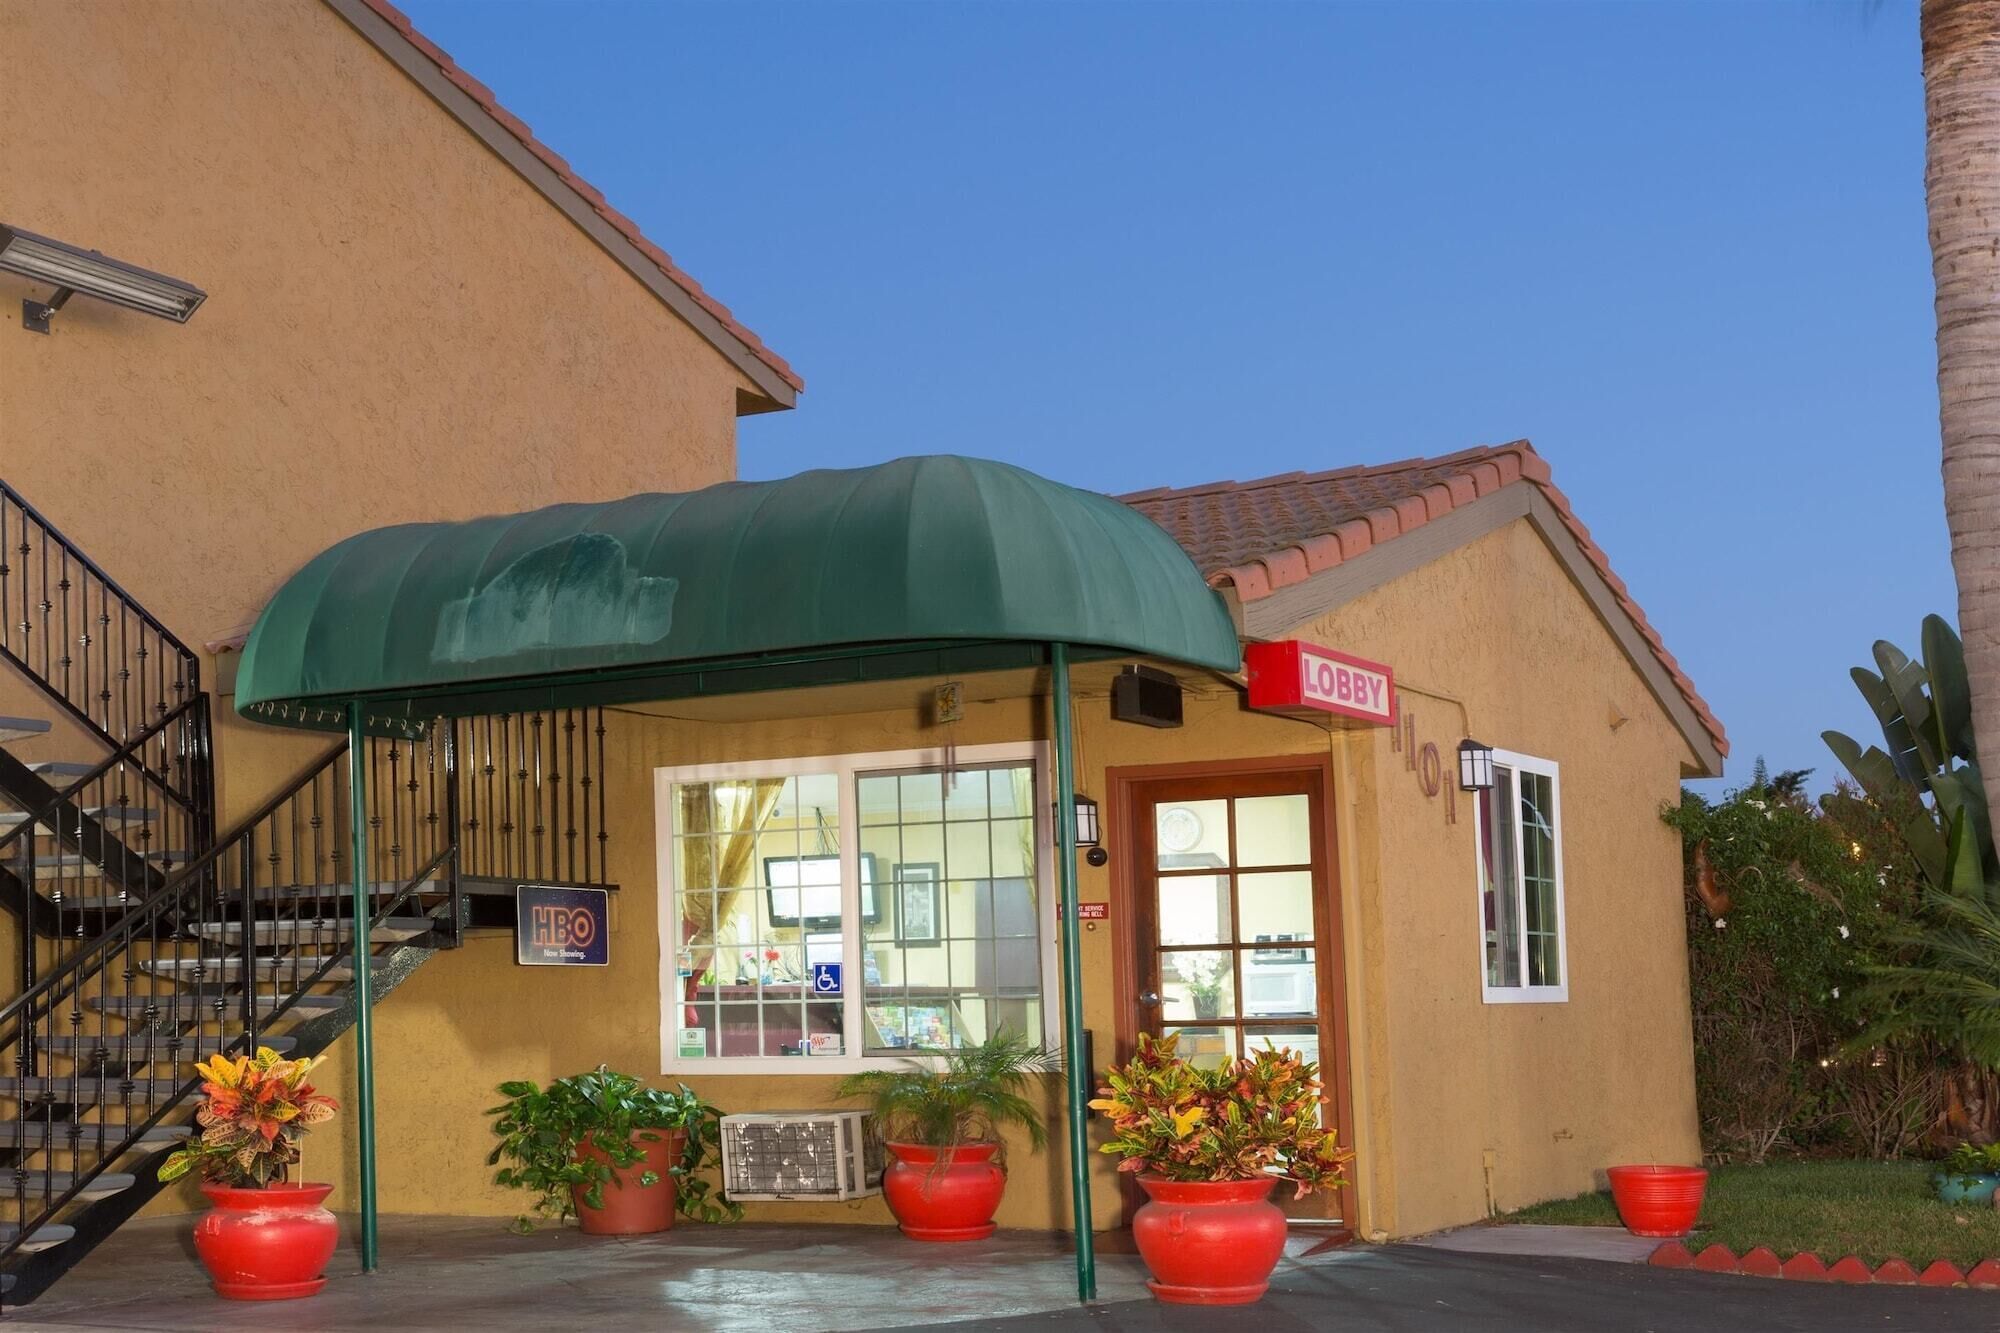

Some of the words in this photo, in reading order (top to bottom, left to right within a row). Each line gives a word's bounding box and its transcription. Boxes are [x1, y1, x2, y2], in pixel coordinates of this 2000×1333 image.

[1304, 658, 1382, 709] LOBBY
[533, 906, 595, 947] HBO
[544, 949, 558, 957] Now
